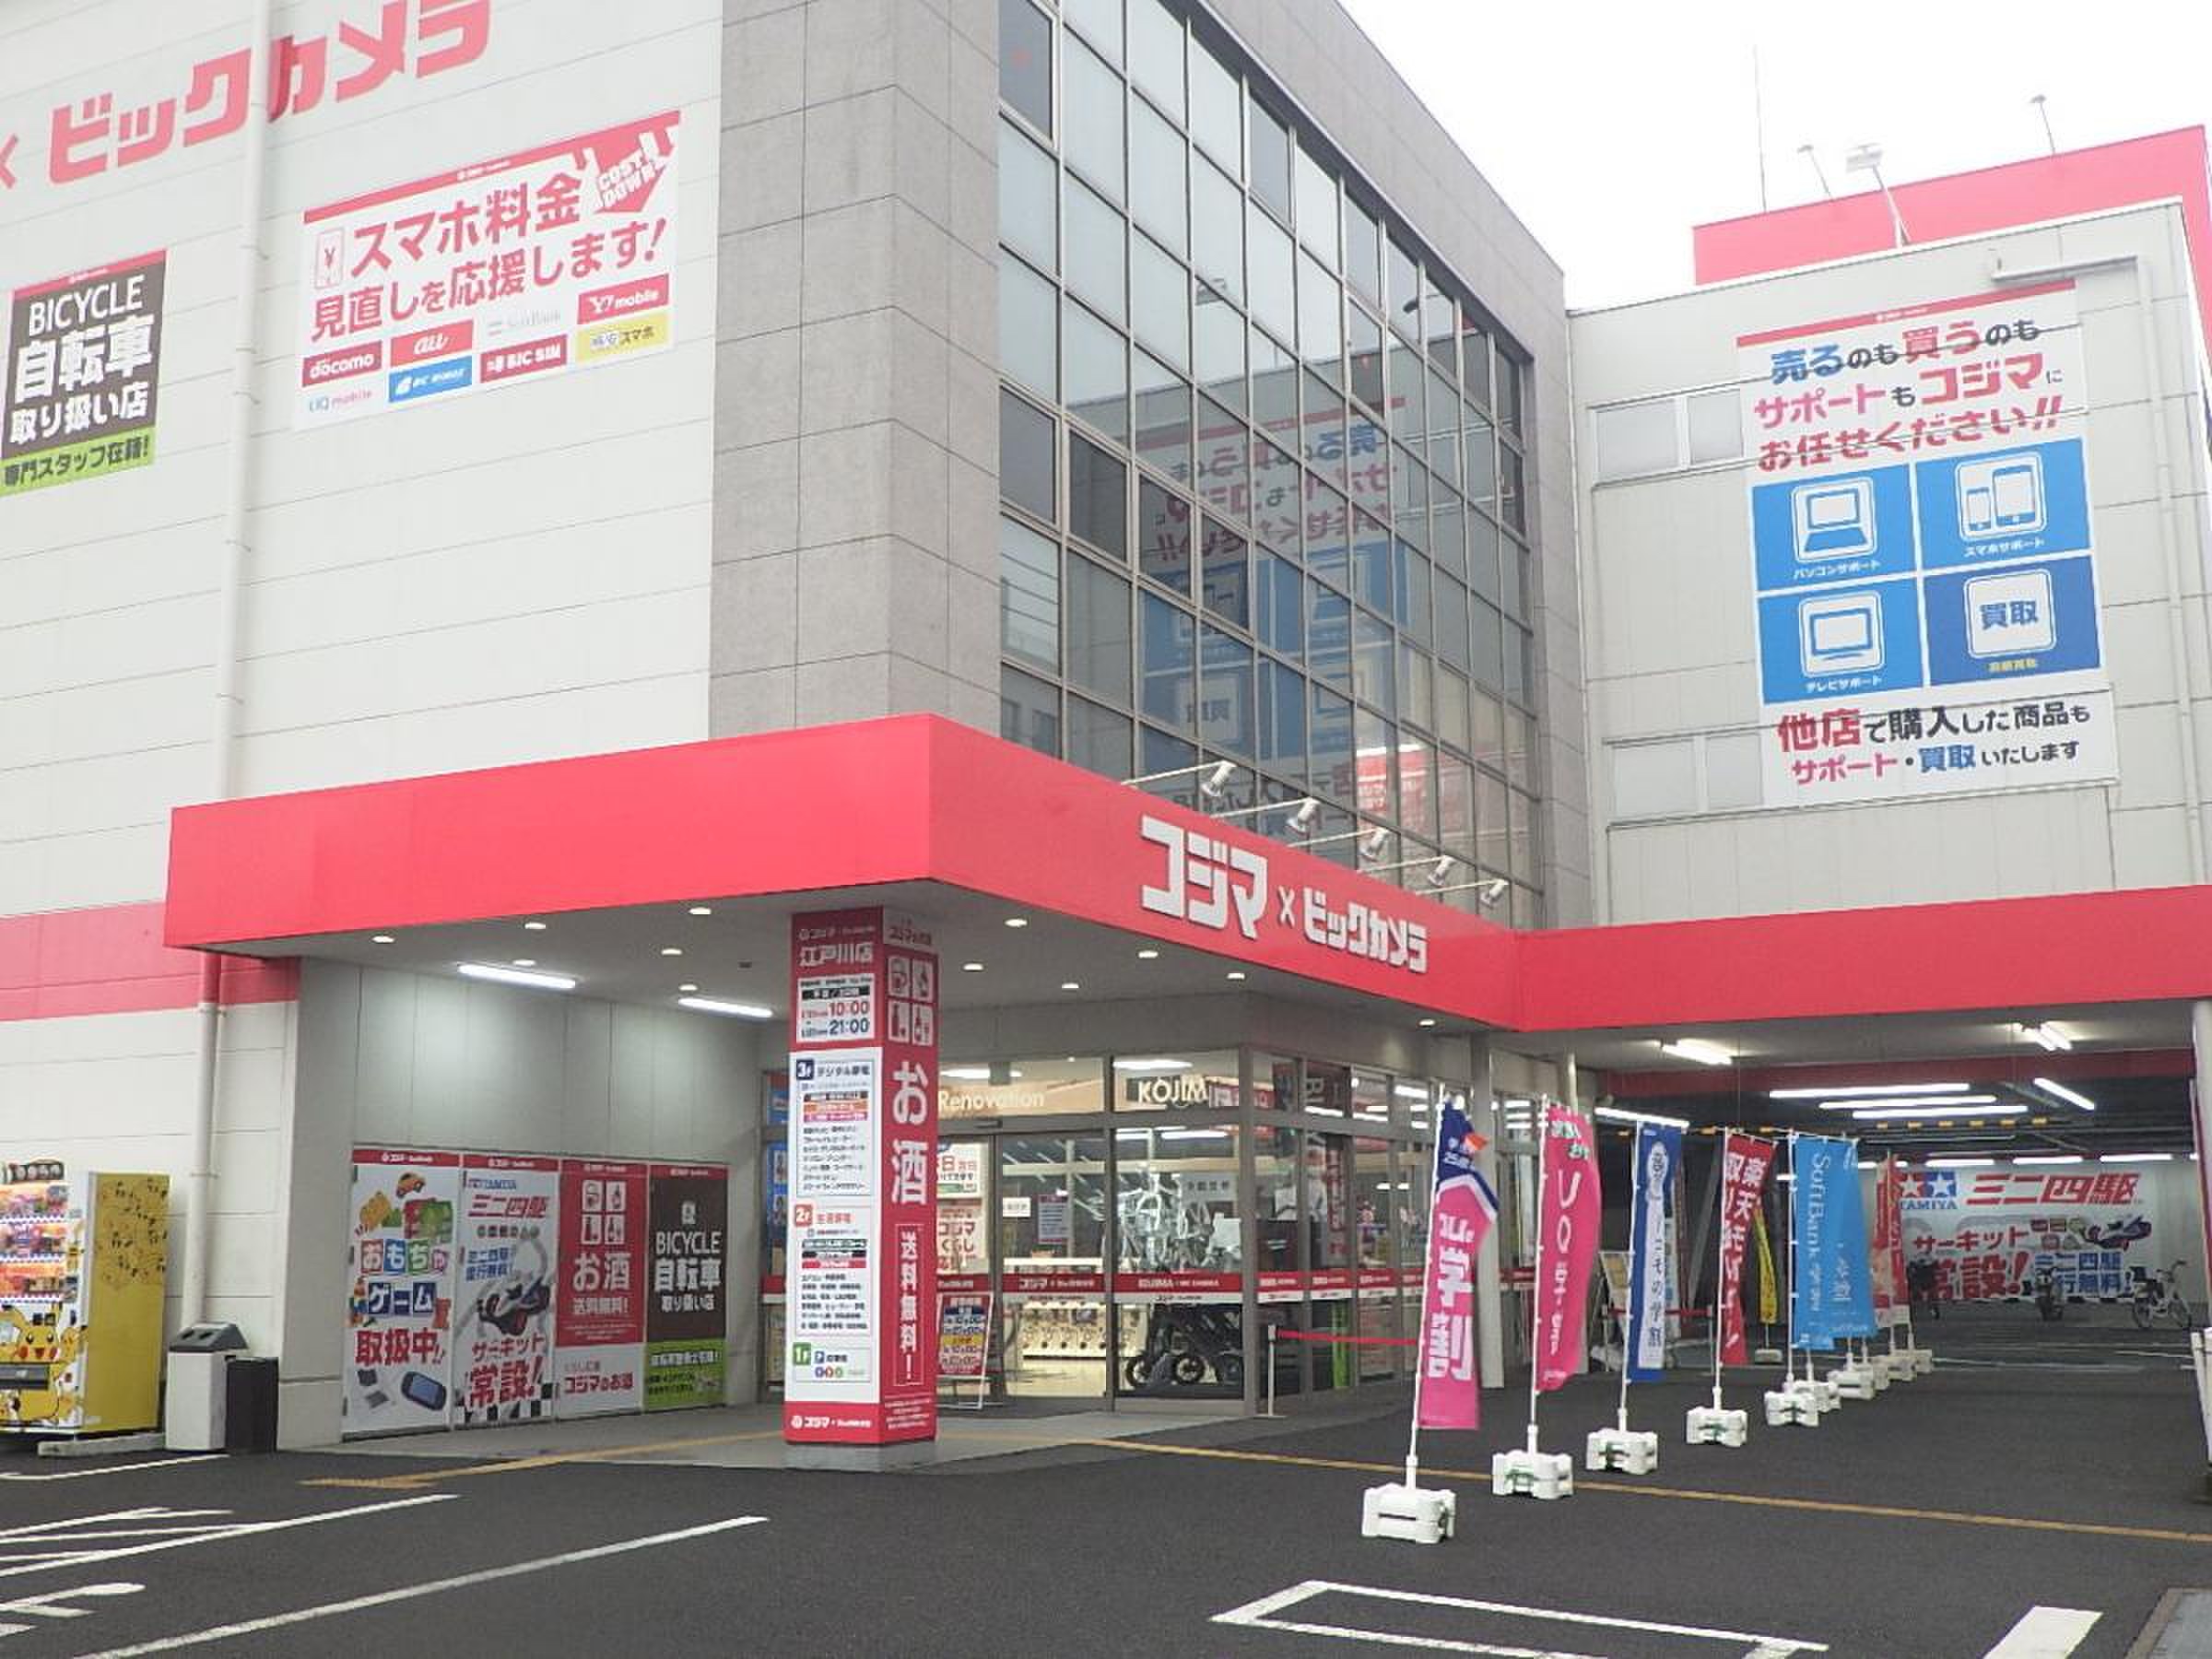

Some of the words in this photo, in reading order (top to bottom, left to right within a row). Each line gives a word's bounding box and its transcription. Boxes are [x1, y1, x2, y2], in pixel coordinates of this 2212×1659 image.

[351, 171, 582, 278] スマホ料金
[312, 218, 665, 341] 見直しを応援します!
[29, 274, 145, 337] BICYCLE
[15, 313, 155, 404] 自転車
[310, 351, 374, 380] docomo
[1771, 320, 2041, 384] 売るのも買うのも
[10, 381, 148, 445] 取り扱い店
[1755, 353, 2063, 429] サポートもコジマに
[1759, 395, 2063, 472] お任せください!!
[1979, 600, 2040, 631] 買取
[1777, 700, 2091, 753] 他店で購入した商品も
[1792, 740, 2080, 785] サポート・買取いたします
[1141, 815, 1267, 940] コジマ
[1303, 887, 1428, 975] ビックカメラ
[799, 942, 873, 967] 江戸川店
[829, 1001, 869, 1017] 10:00
[829, 1018, 869, 1035] 21:00
[892, 1061, 928, 1205] お酒
[1966, 1172, 2142, 1206] ミニ四駆
[655, 1230, 722, 1254] BICYCLE
[1913, 1225, 2030, 1254] サーキット
[571, 1252, 632, 1292] お酒
[654, 1257, 722, 1292] 自転車
[368, 1282, 436, 1316] ゲーム
[471, 1332, 547, 1362] サーキット
[468, 1356, 544, 1406] 常設!
